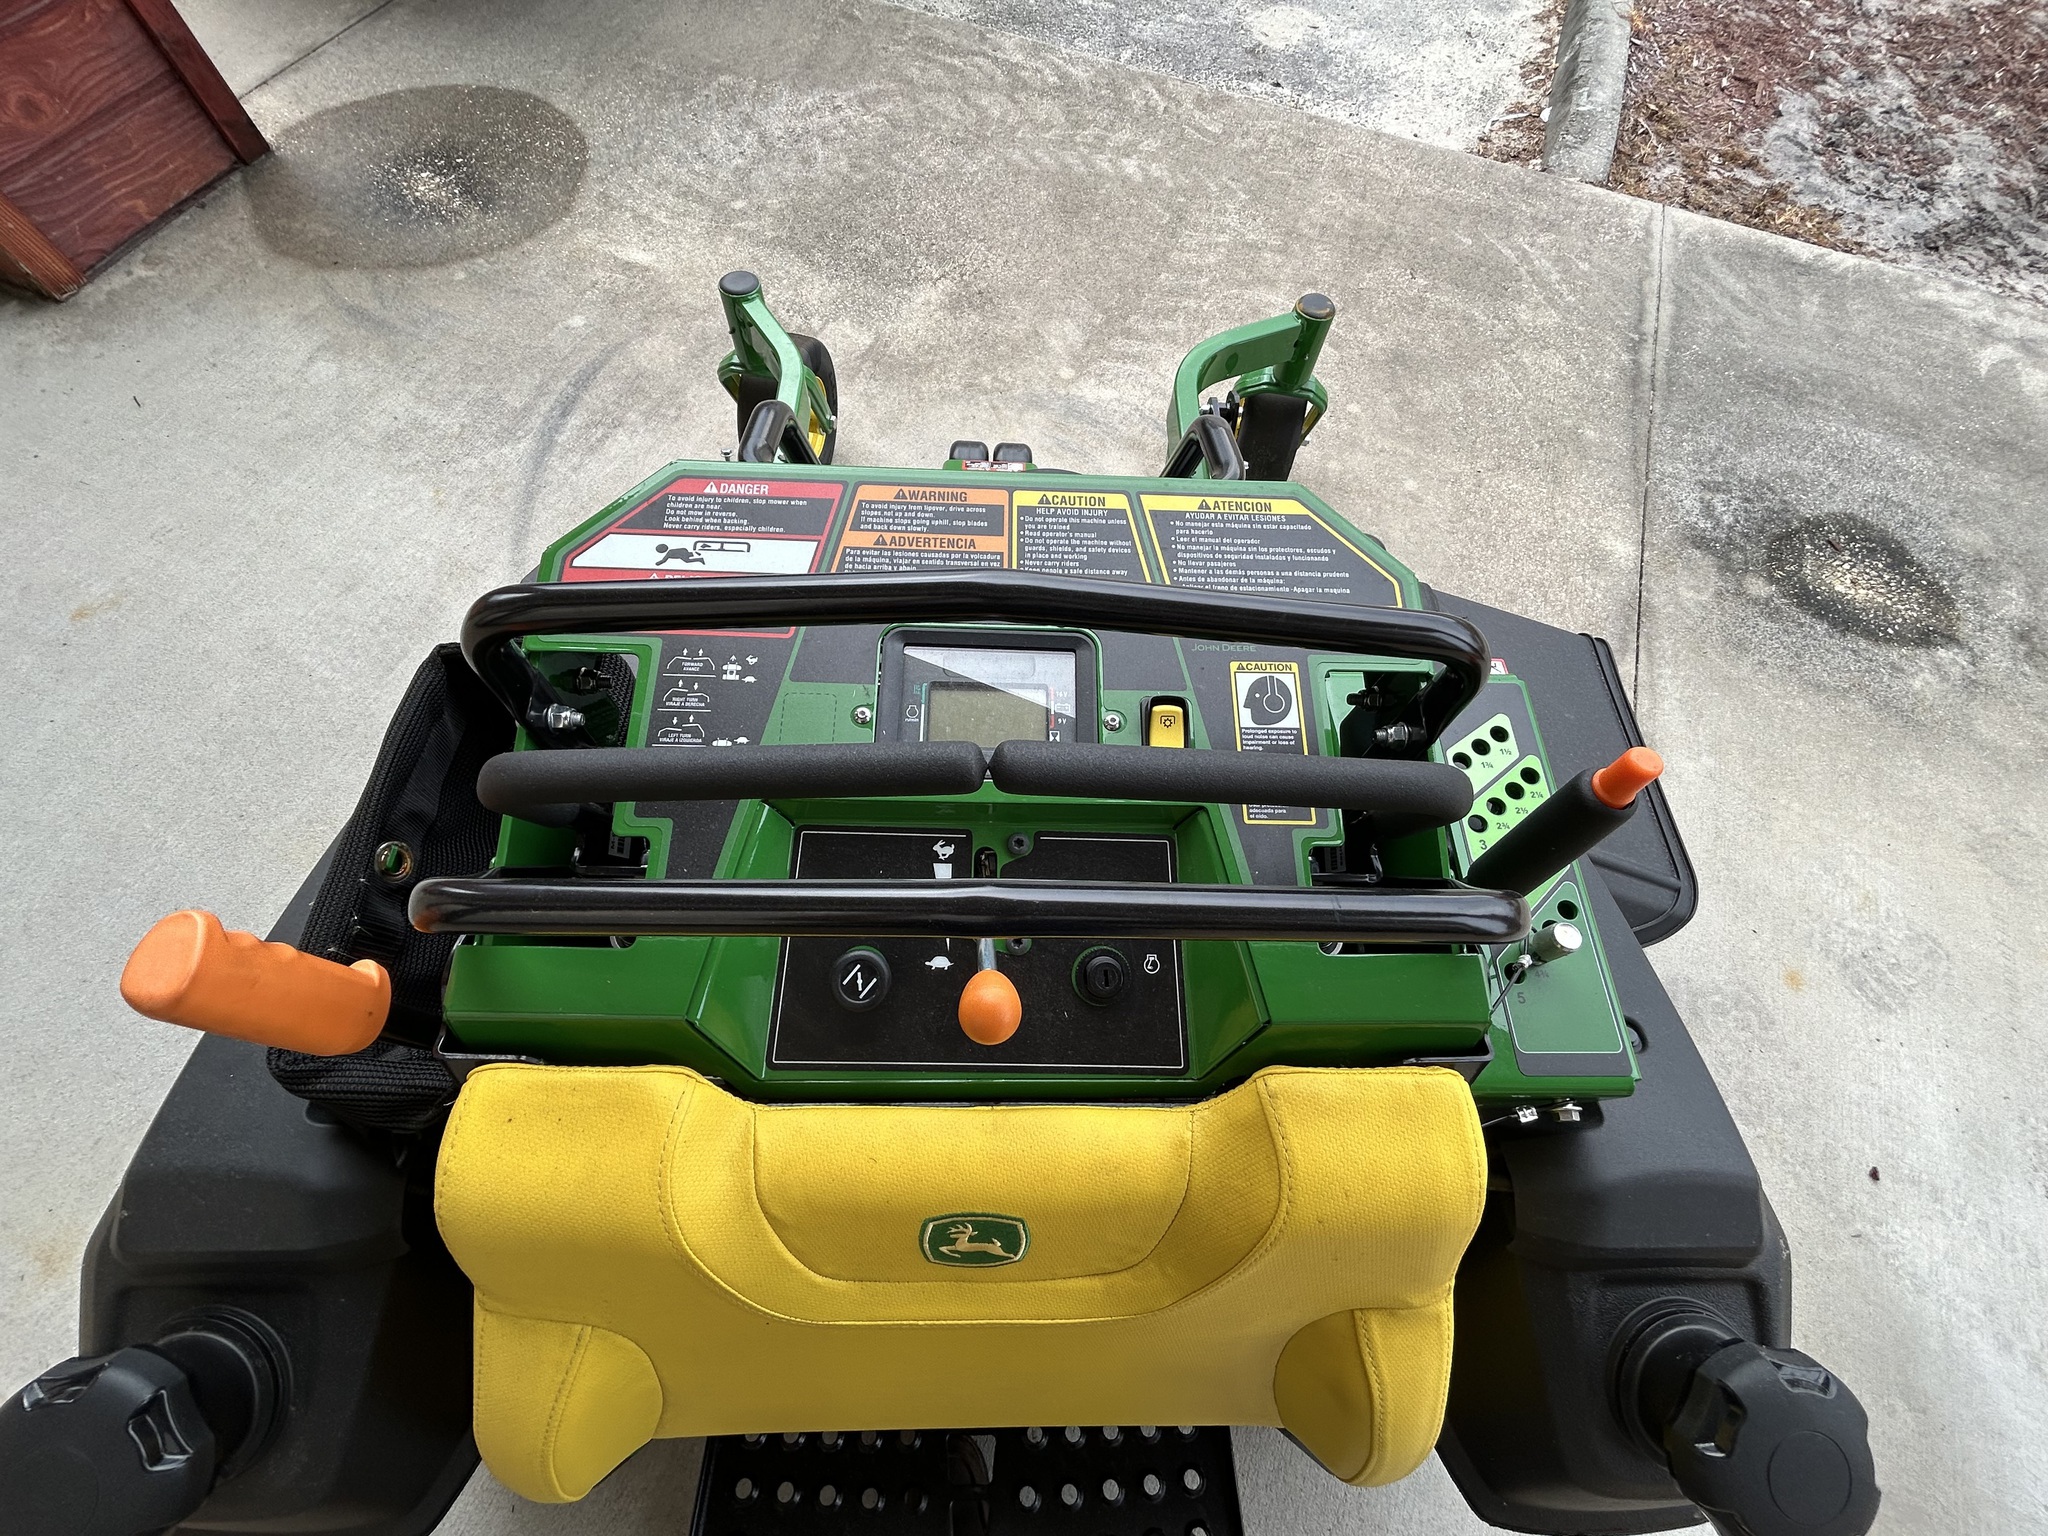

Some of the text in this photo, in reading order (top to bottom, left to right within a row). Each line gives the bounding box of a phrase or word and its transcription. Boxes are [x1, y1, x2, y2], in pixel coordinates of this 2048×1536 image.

[720, 483, 768, 494] DANGER
[908, 491, 967, 502] WARNING
[1052, 495, 1105, 506] CAUTION
[1213, 500, 1272, 512] ATENCION
[889, 536, 976, 549] ADVERTENCIA
[1192, 643, 1219, 652] JOHN
[1246, 663, 1292, 671] CAUTION
[1497, 822, 1510, 830] 2¾
[1479, 840, 1488, 849] 3
[1517, 992, 1526, 1003] 5
